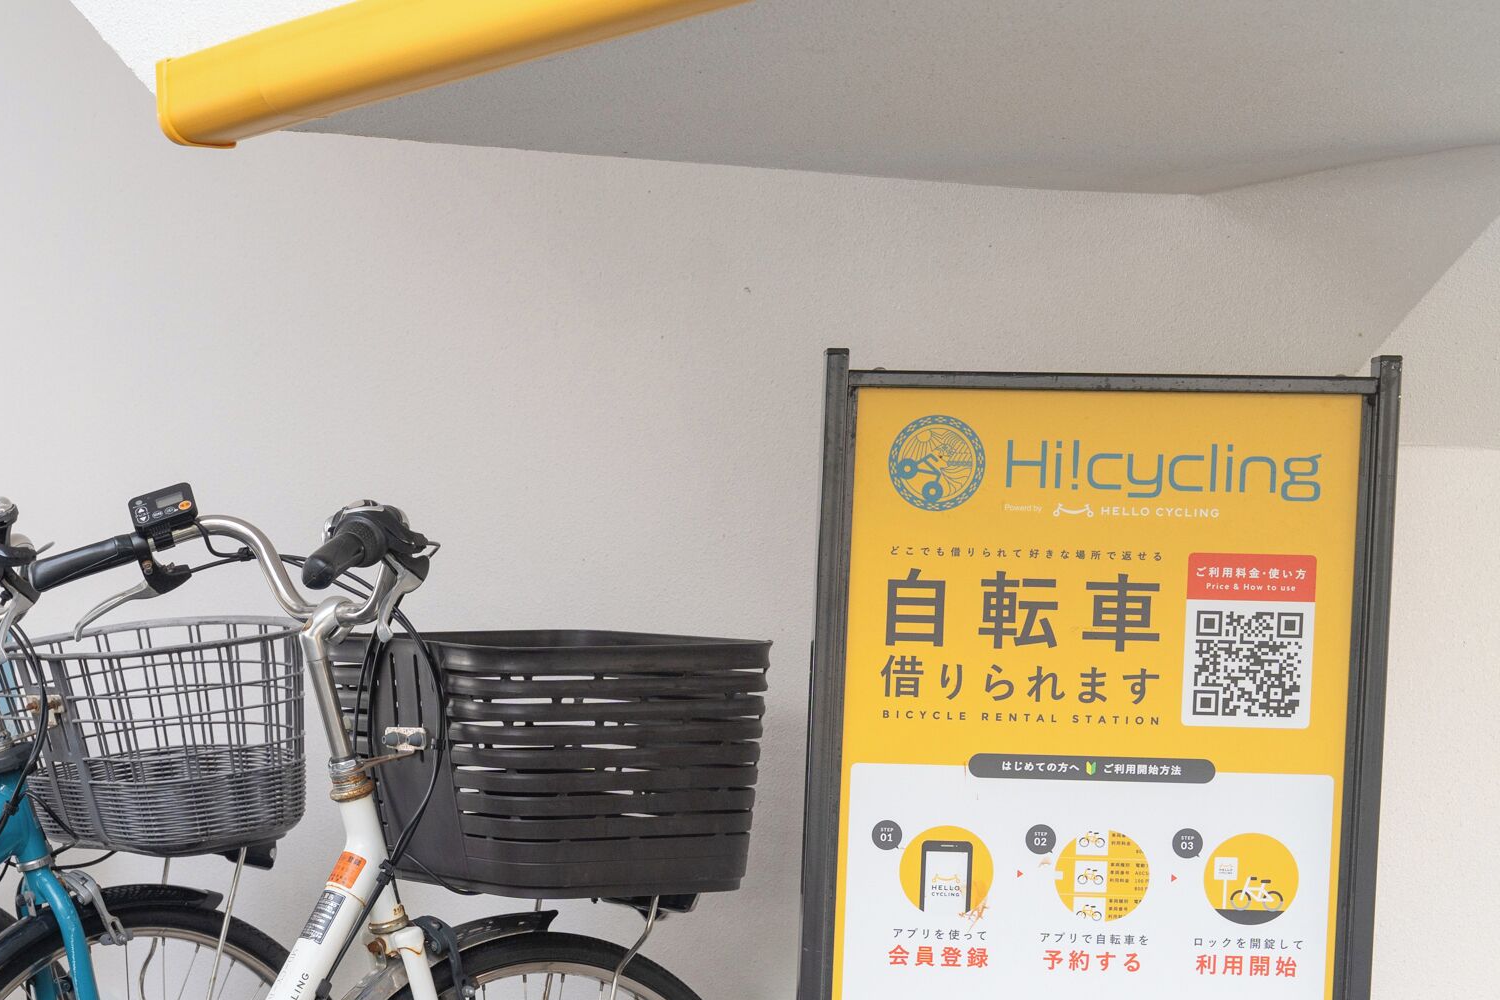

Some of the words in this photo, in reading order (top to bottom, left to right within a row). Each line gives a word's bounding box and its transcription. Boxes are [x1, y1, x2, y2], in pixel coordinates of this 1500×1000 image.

[1005, 439, 1322, 502] Hi!cycling
[1033, 504, 1043, 514] by
[1100, 506, 1150, 517] HELLO
[1155, 507, 1220, 518] CYCLING
[890, 546, 1162, 561] どこでも借りられて好きな場所で返せる
[1196, 566, 1307, 580] ご利用料金・使い方
[1206, 582, 1230, 591] Price
[1233, 583, 1239, 591] &
[1243, 583, 1263, 592] How
[1266, 584, 1277, 592] to
[885, 568, 1160, 652] 自転車
[880, 654, 1160, 705] 借りられます
[882, 709, 967, 721] BICYCLE
[981, 712, 1057, 723] RENTAL
[1071, 714, 1160, 726] STATION
[1002, 761, 1080, 773] はじめての方へ
[1103, 764, 1182, 776] ご利用開始方法
[880, 833, 893, 842] 01
[1033, 837, 1047, 847] 02
[1180, 841, 1194, 850] 03
[893, 928, 987, 941] アプリを使って
[1040, 932, 1149, 946] アプリで自転車を
[1193, 937, 1304, 950] ロックを開錠して
[888, 944, 989, 968] 会員登録
[1043, 950, 1141, 973] 予約する
[1195, 954, 1297, 978] 利用開始
